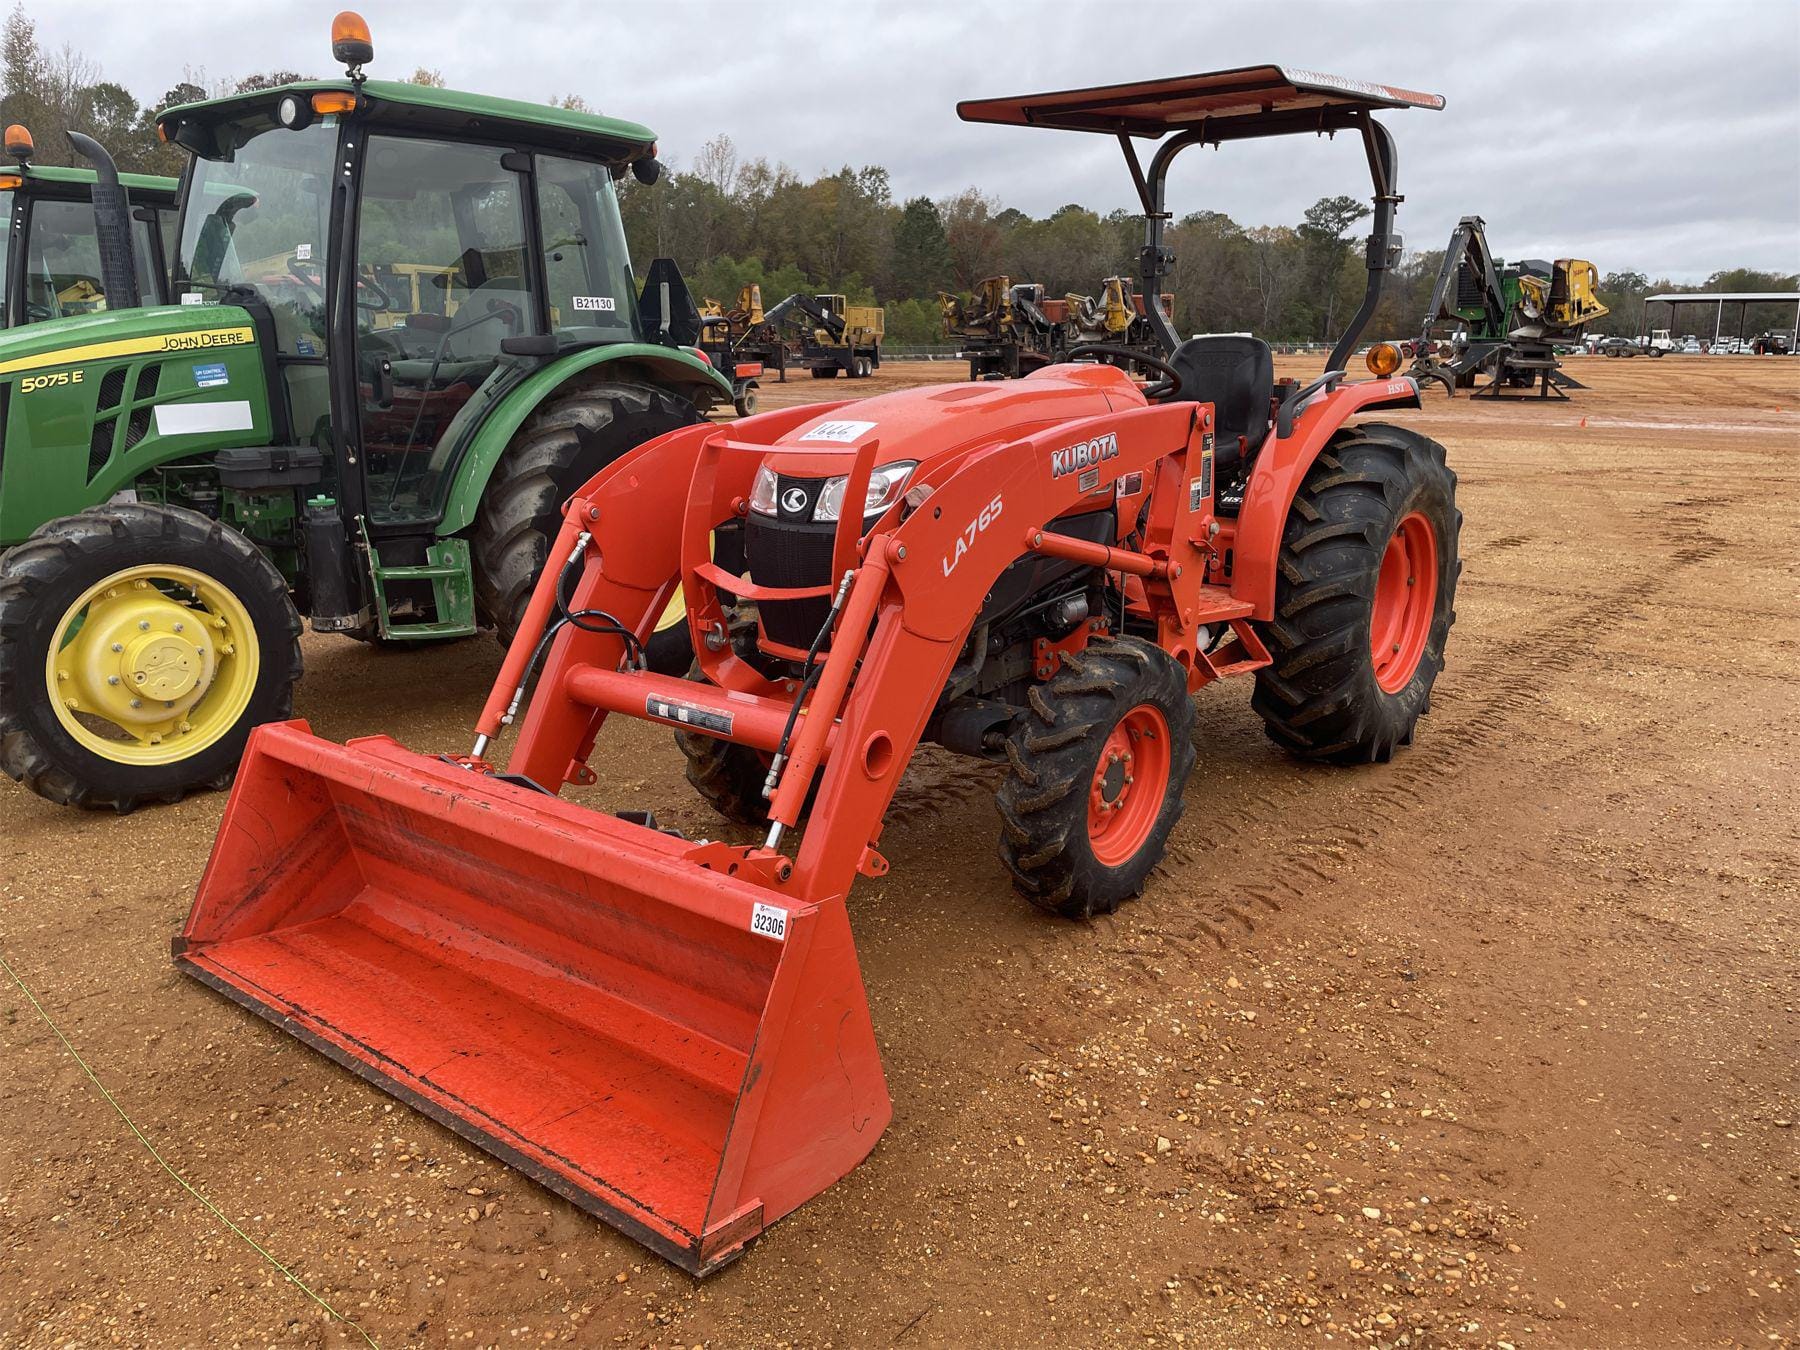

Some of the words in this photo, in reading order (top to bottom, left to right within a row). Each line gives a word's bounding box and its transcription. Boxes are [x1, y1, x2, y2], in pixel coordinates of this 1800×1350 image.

[576, 298, 612, 309] B21130
[161, 336, 199, 350] JOHN
[200, 332, 244, 346] DEERE
[21, 372, 69, 393] 5075
[72, 370, 84, 384] E
[1388, 382, 1406, 395] HST
[1052, 433, 1119, 479] KUBOTA
[943, 493, 1003, 577] LA765
[754, 913, 785, 936] 32306
